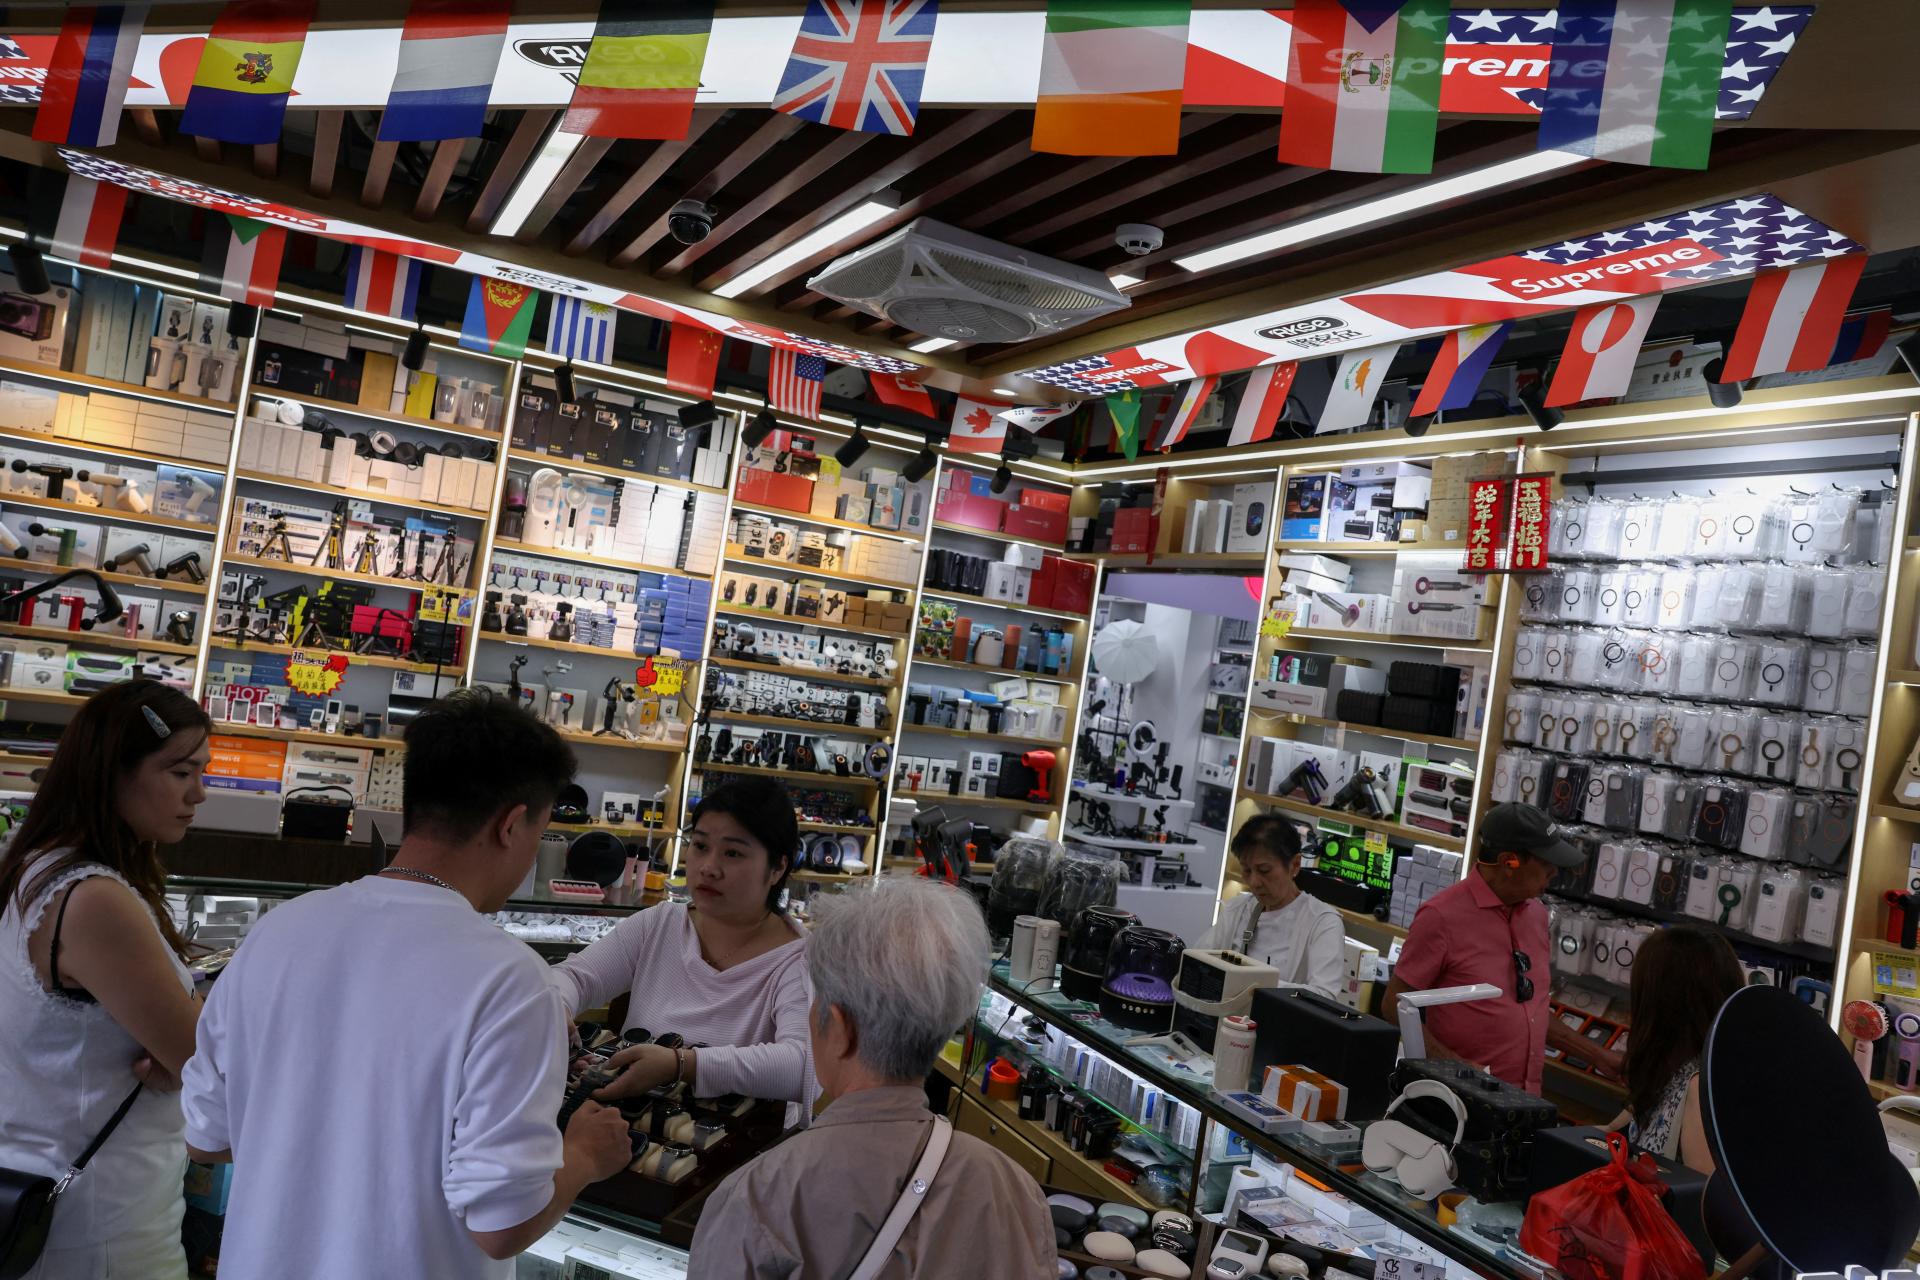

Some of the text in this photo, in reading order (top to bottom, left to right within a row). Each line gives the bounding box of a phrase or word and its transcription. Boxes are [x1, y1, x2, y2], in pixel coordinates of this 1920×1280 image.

[159, 180, 320, 228] Supreme
[1511, 244, 1703, 294] Supreme
[737, 328, 855, 359] Supreme
[1086, 360, 1169, 384] Supreme
[1471, 484, 1498, 568] 蛇年大吉
[1516, 481, 1543, 567] 五福临门
[226, 685, 268, 701] HOT
